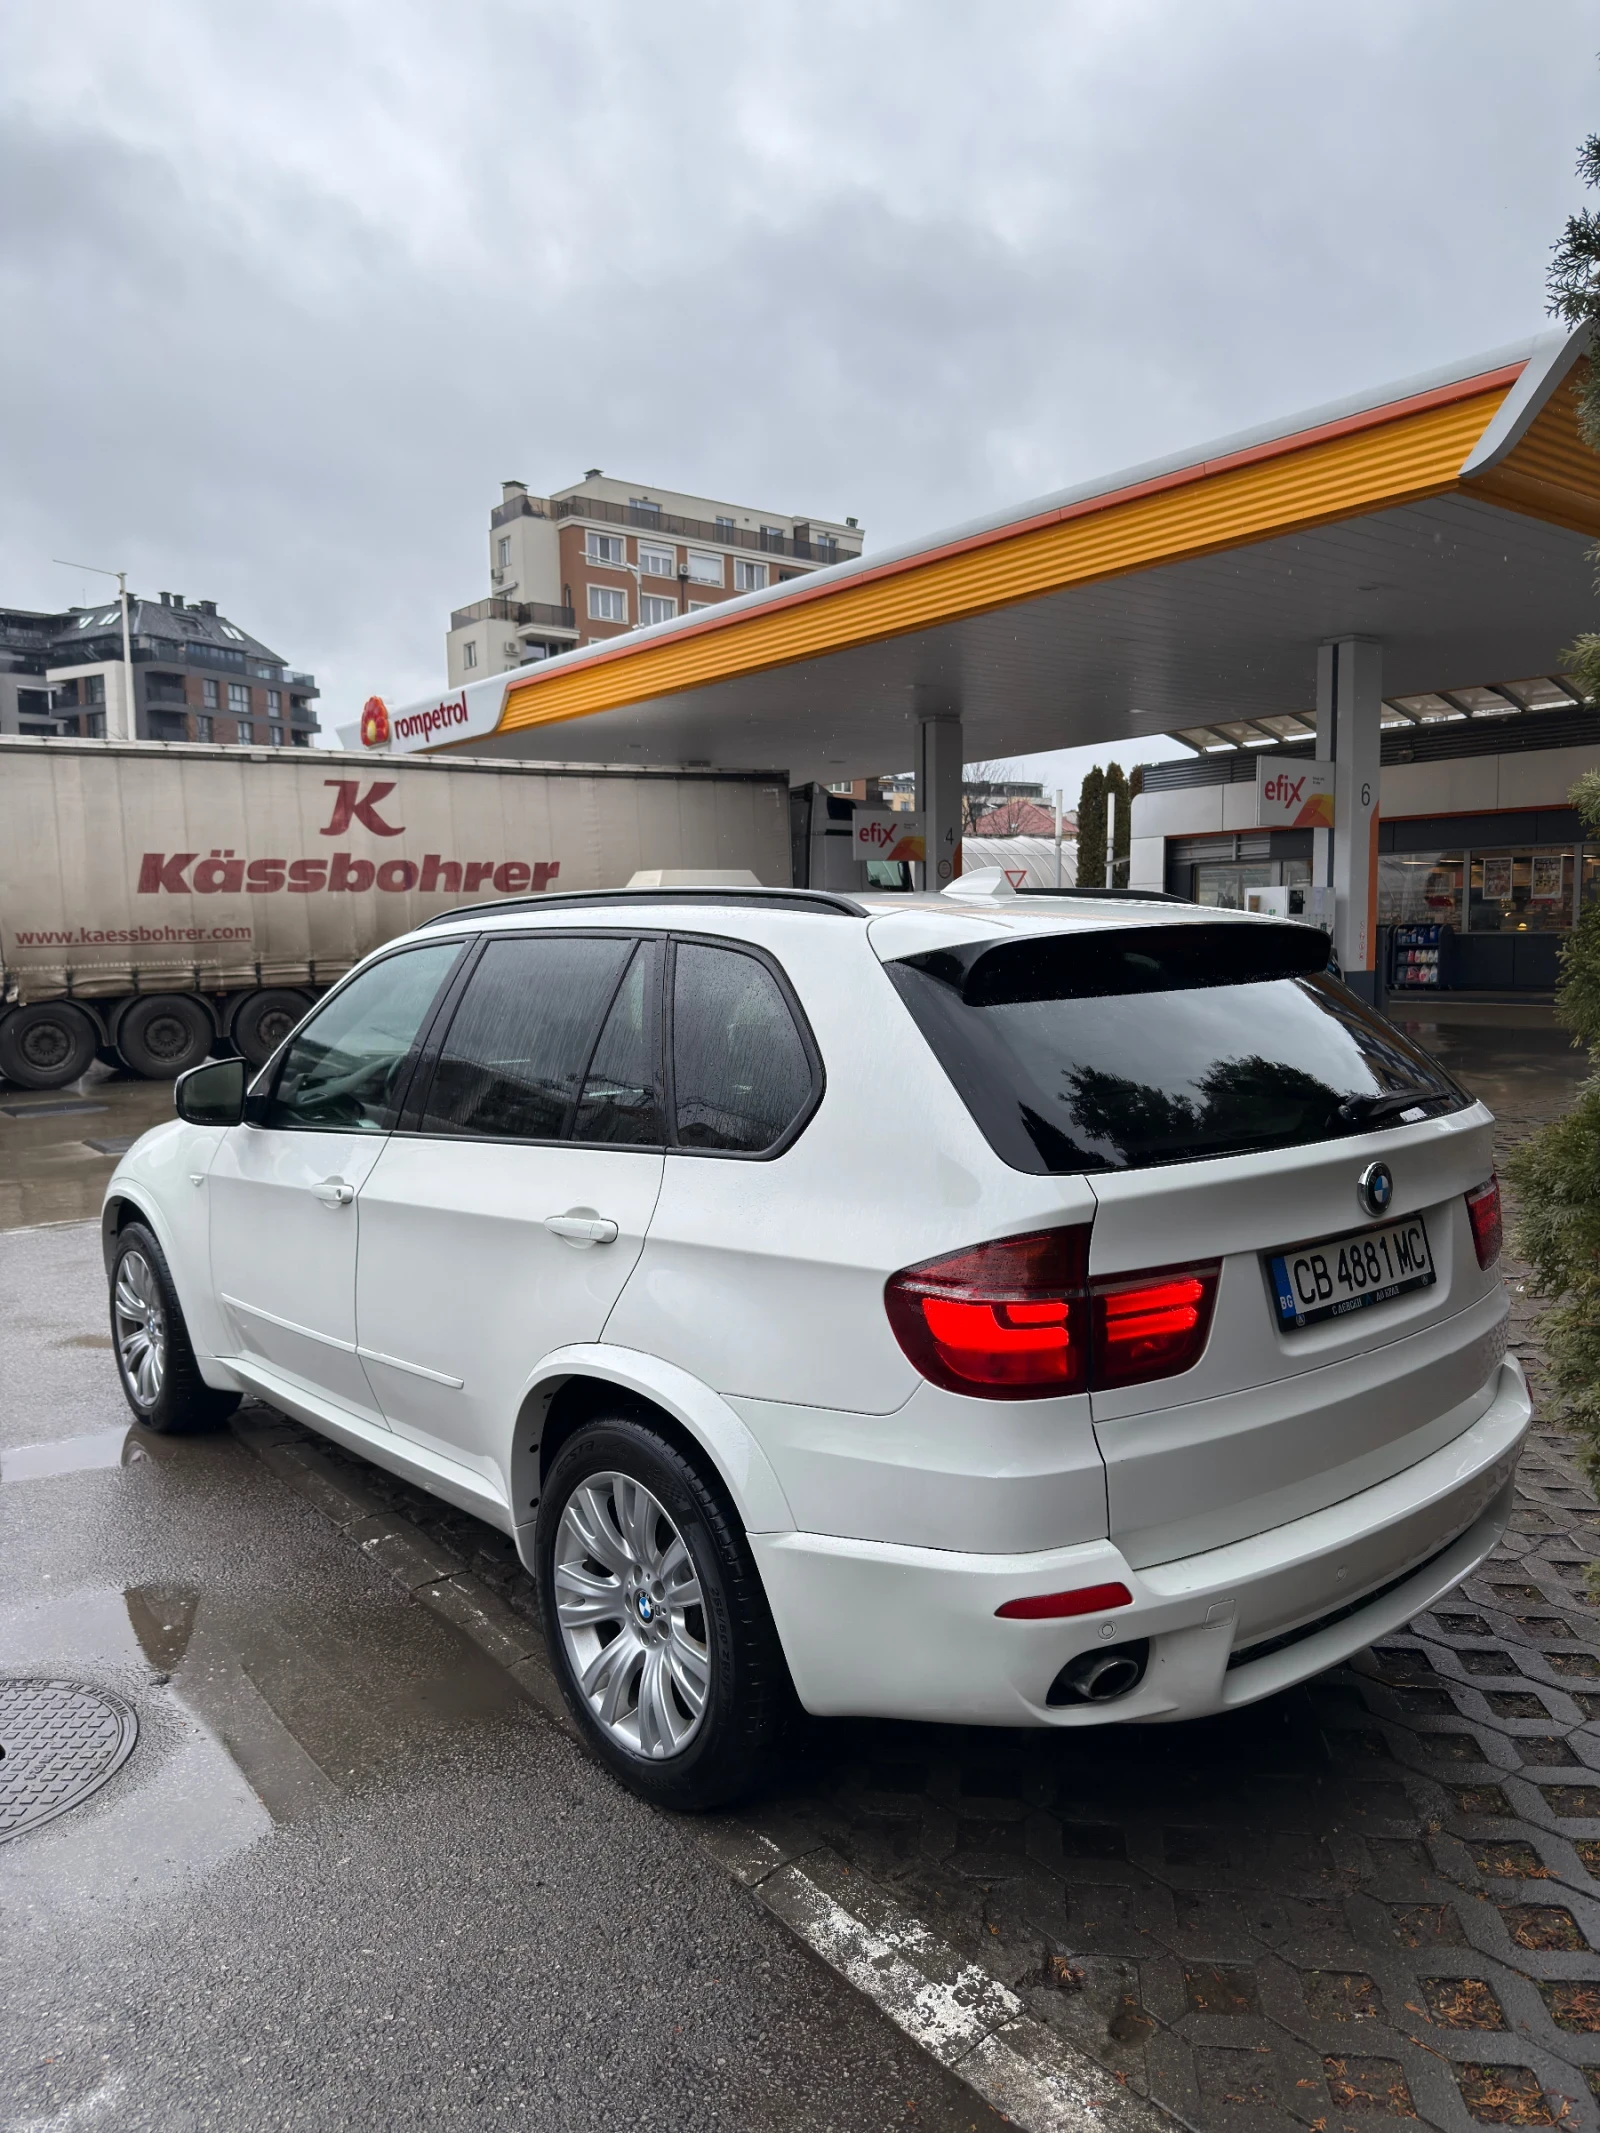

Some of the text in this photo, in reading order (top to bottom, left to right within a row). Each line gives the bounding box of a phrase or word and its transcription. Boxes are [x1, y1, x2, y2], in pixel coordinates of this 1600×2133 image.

[394, 690, 468, 742] rompetrol
[1264, 774, 1306, 809] efix
[1361, 783, 1371, 806] 6
[859, 823, 898, 848] efix
[944, 827, 954, 845] 4
[137, 849, 560, 894] Kässbohrer
[15, 925, 252, 946] www.kaessbohrer.com
[1294, 1227, 1426, 1305] CB 4881 MC
[1280, 1295, 1295, 1311] BG
